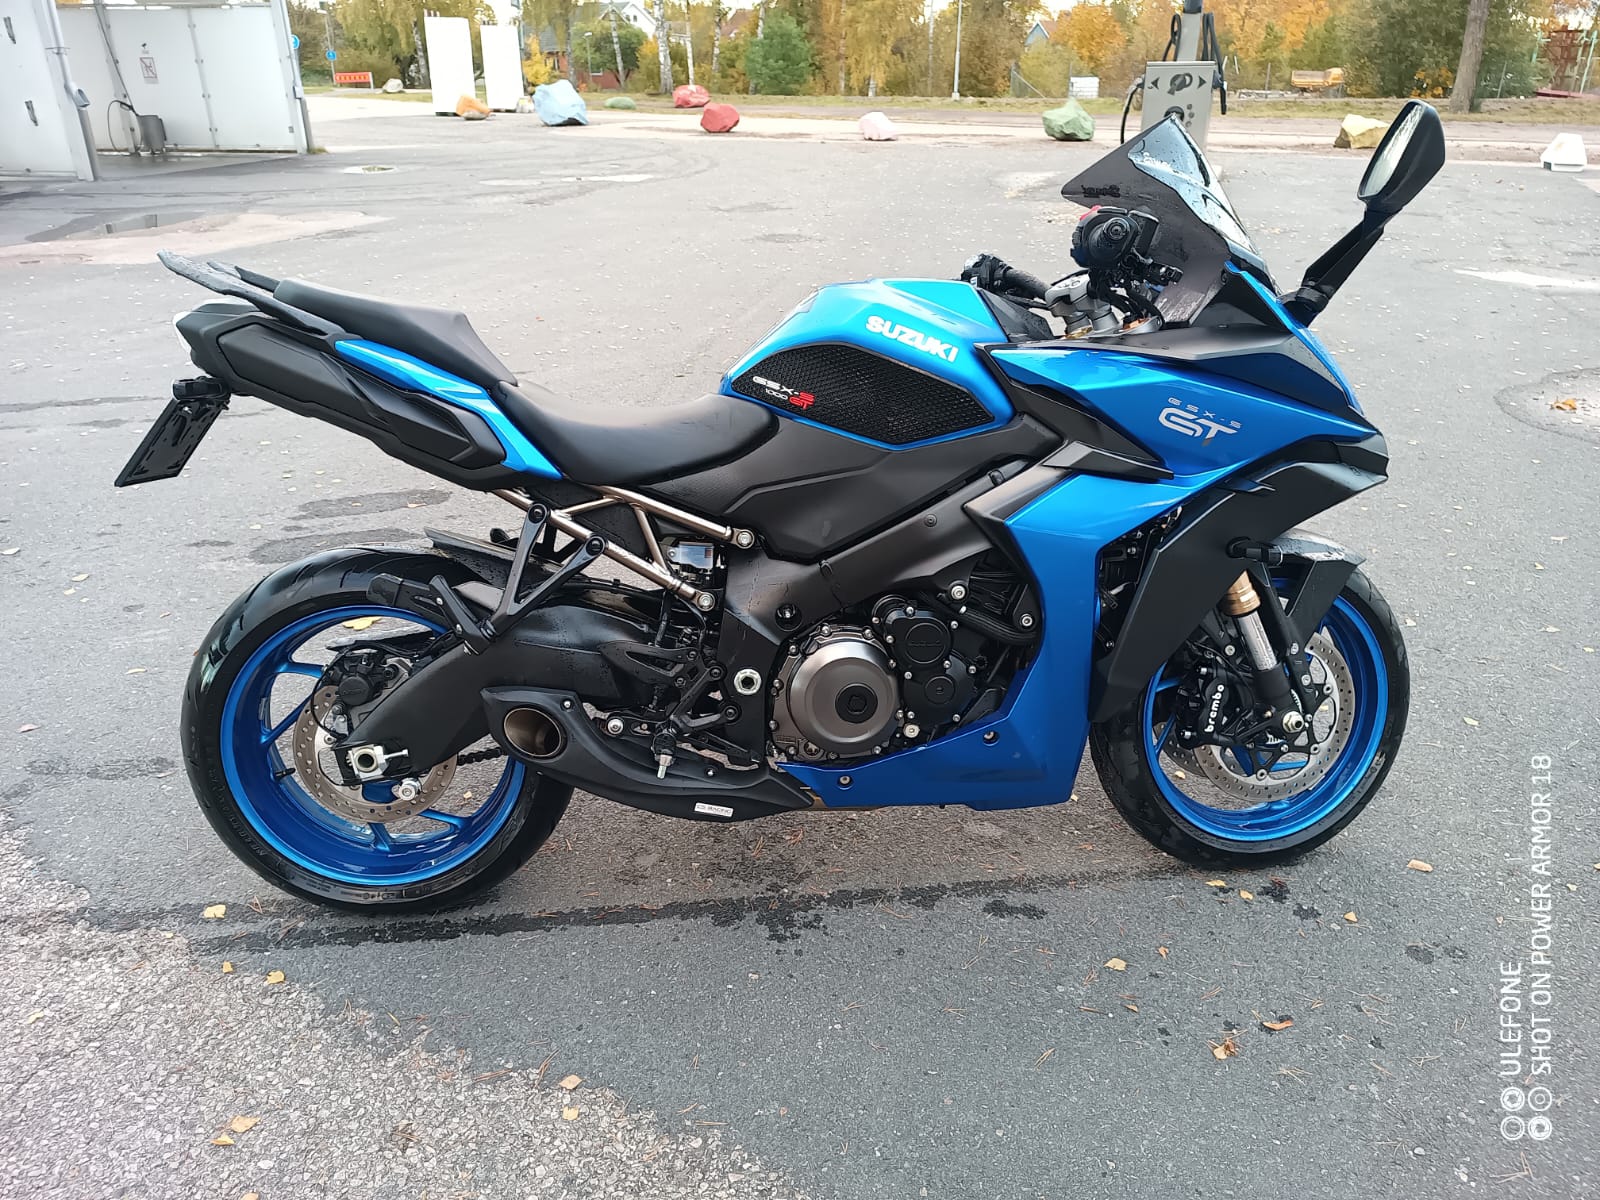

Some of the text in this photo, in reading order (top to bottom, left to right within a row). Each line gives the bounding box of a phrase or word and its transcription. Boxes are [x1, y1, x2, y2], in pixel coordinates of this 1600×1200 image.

[865, 315, 959, 363] SUZUKI
[765, 388, 788, 400] 1000
[1158, 407, 1237, 439] GT
[1204, 684, 1225, 733] brembo
